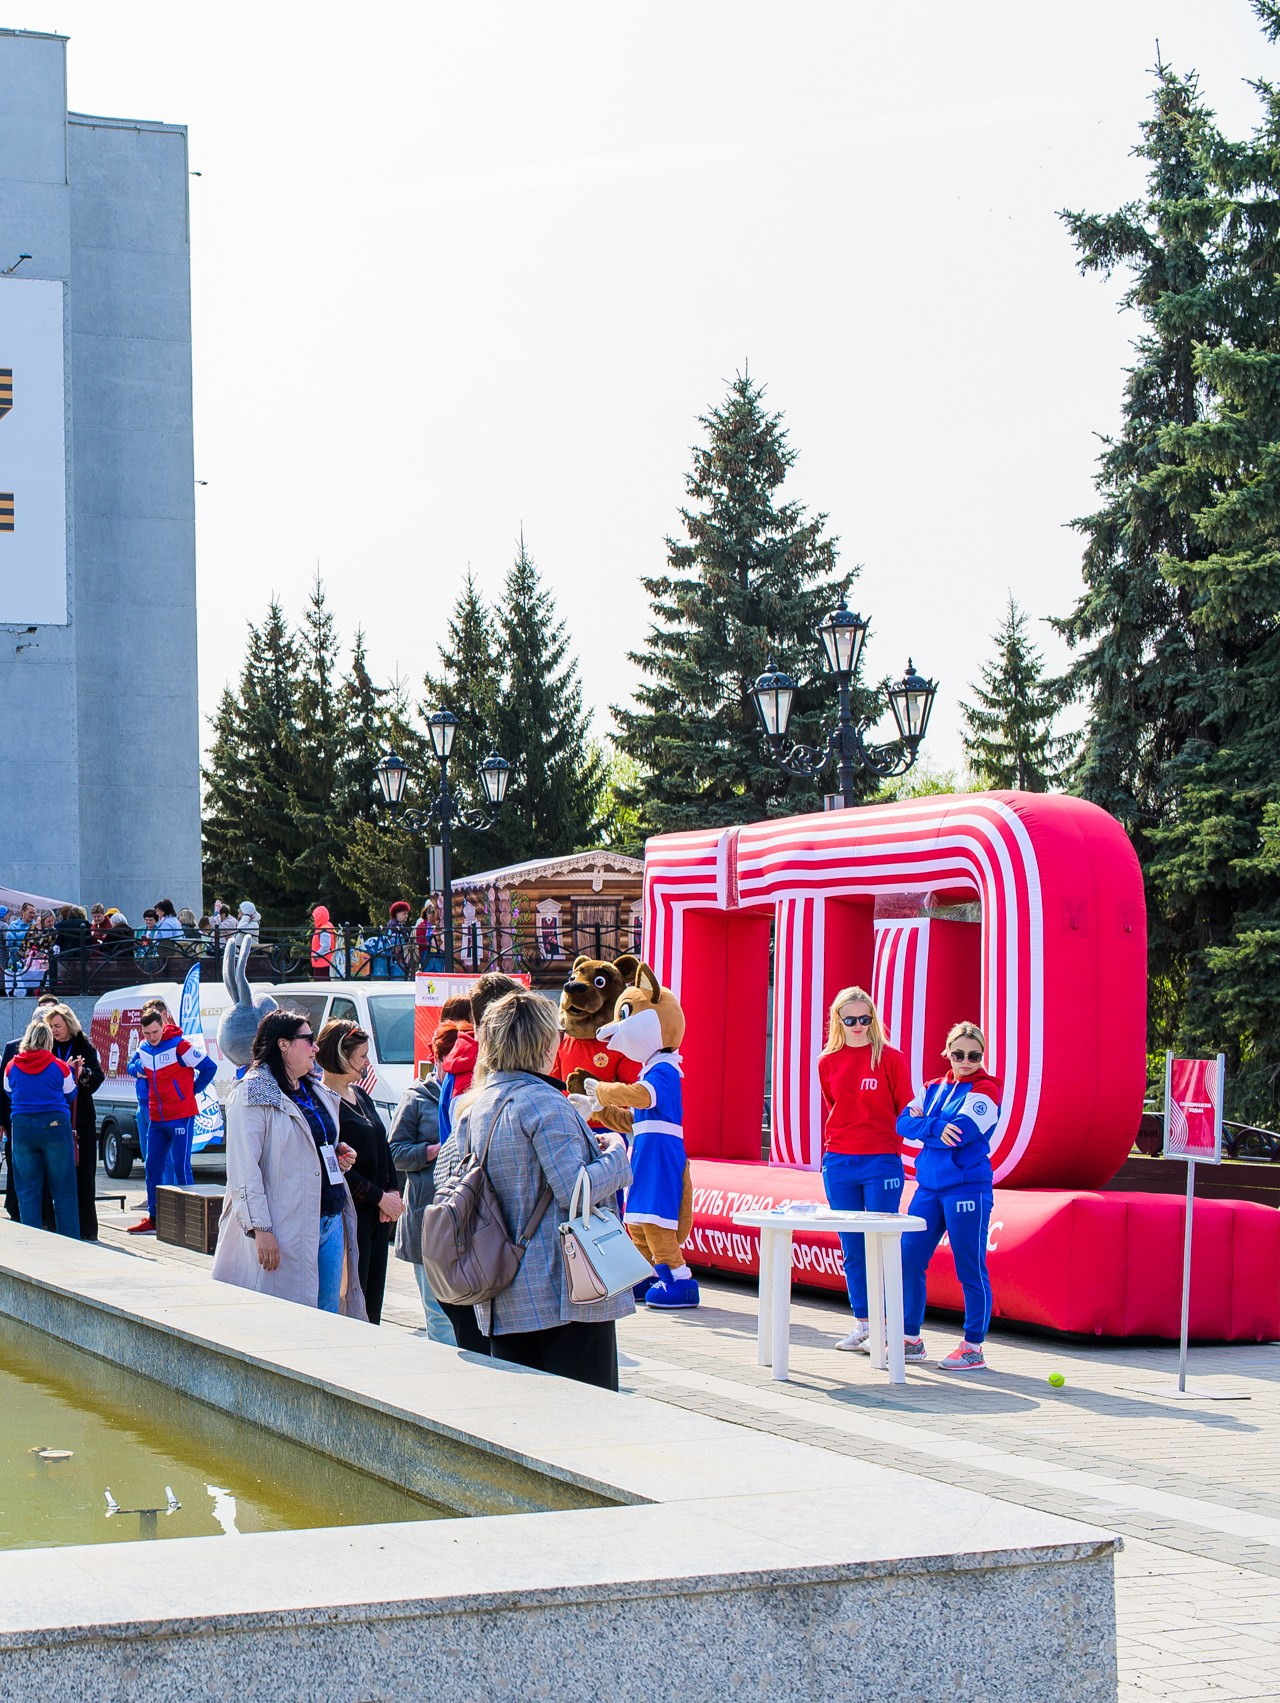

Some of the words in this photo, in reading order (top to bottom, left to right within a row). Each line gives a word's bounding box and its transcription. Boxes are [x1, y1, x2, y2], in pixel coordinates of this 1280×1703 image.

[860, 1078, 878, 1090] ГТО
[174, 1127, 186, 1136] ГТО
[884, 1177, 901, 1190] ГТО
[956, 1200, 976, 1213] ГТО
[693, 1228, 708, 1253] К
[705, 1230, 753, 1265] ТРУДУ
[792, 1243, 846, 1277] ОРОНЕ
